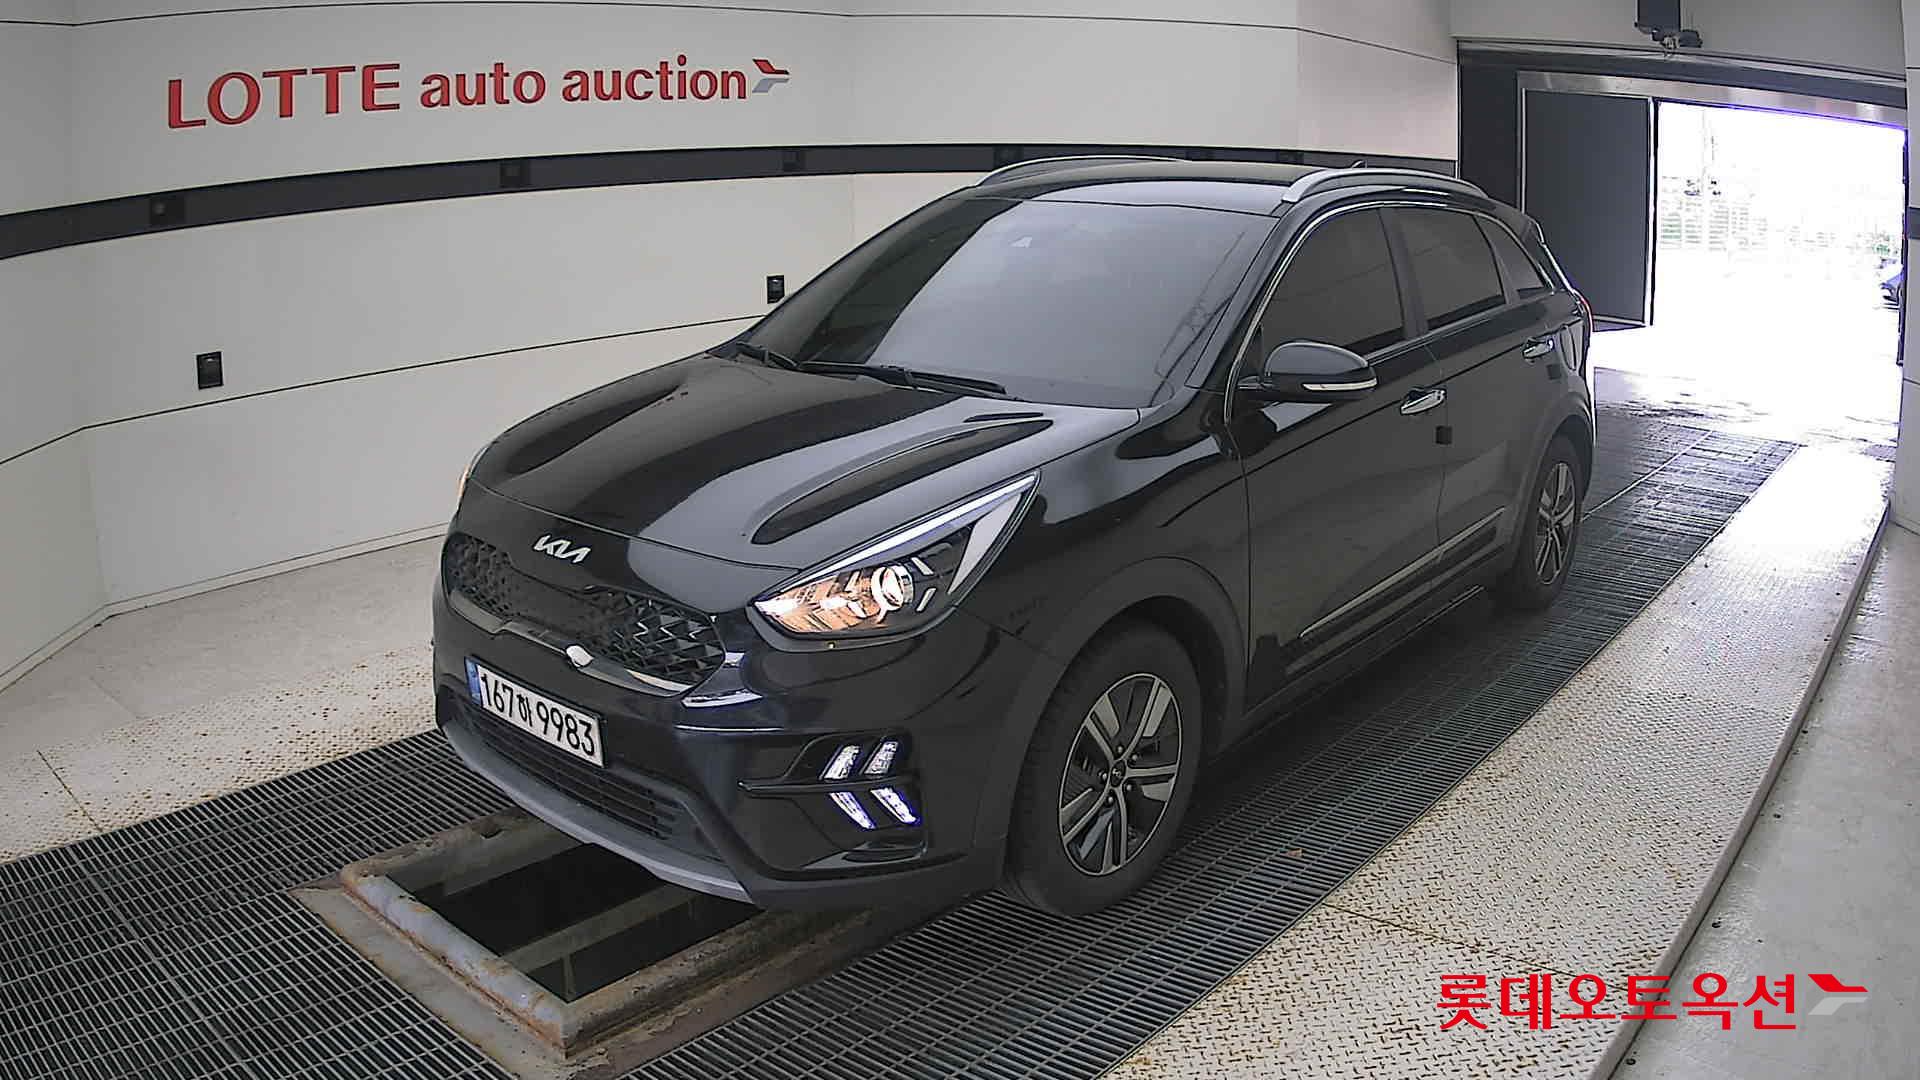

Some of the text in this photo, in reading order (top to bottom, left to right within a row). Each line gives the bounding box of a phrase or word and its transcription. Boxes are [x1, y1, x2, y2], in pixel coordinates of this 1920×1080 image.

[168, 54, 747, 129] LOTTE auto auction
[533, 535, 591, 563] KIA
